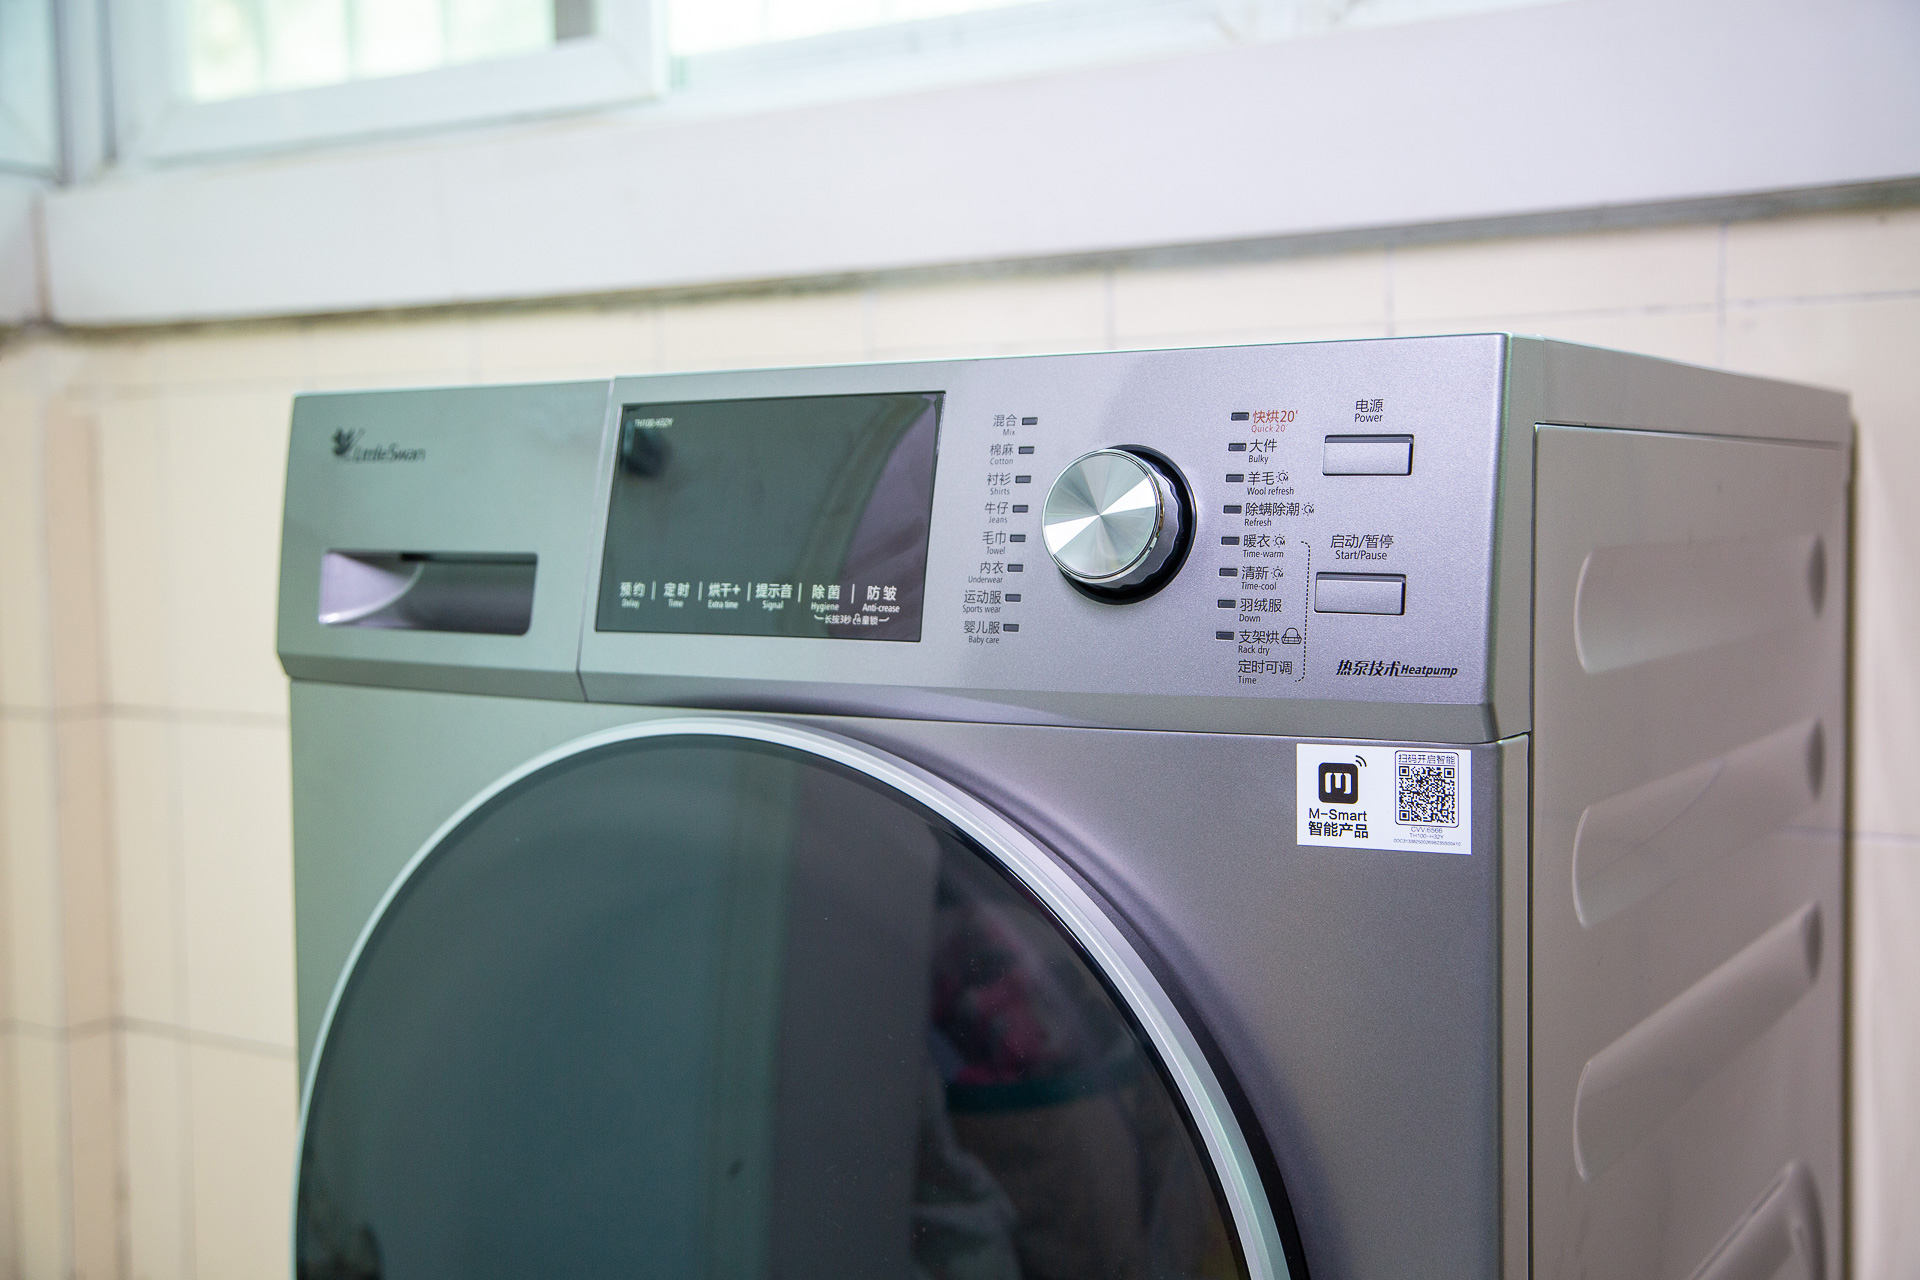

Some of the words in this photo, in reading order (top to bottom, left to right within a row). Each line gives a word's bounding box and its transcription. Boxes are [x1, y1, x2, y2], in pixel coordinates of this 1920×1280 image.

[1355, 399, 1384, 413] 电源
[993, 414, 1017, 427] 混合
[1355, 414, 1383, 422] Power
[990, 444, 1014, 456] 棉麻
[1249, 439, 1277, 453] 大件
[1249, 455, 1269, 464] Bulky
[987, 473, 1011, 485] 衬衫
[1247, 471, 1274, 485] 羊毛
[990, 487, 1010, 495] Shirts
[1247, 487, 1266, 495] Wool
[1268, 487, 1294, 495] refresh
[985, 502, 1009, 515] 牛仔
[1245, 503, 1300, 516] 除螨除潮
[1244, 518, 1272, 527] Refresh
[983, 531, 1006, 544] 毛巾
[1243, 534, 1270, 547] 暖衣
[1330, 534, 1394, 548] 启动/暂停
[1335, 550, 1387, 560] Start/Pause
[980, 562, 1004, 573] 内衣
[1242, 566, 1269, 580] 清新
[620, 582, 645, 597] 预约
[663, 582, 690, 597] 定时
[756, 584, 792, 599] 提示音
[812, 585, 840, 600] 除菌
[1241, 582, 1276, 590] Time-cool
[867, 586, 897, 600] 防皱
[964, 590, 1001, 604] 运动服
[668, 599, 684, 607] Time
[708, 599, 723, 609] Extra
[725, 600, 738, 609] time
[762, 600, 784, 610] Signal
[811, 602, 839, 612] Hygiene
[862, 603, 900, 612] Anti-crease
[963, 605, 983, 613] Sports
[1240, 598, 1282, 612] 羽绒服
[1239, 614, 1260, 623] Down
[964, 621, 1000, 634] 婴儿服
[969, 636, 984, 644] Baby
[1239, 630, 1279, 644] 支架烘
[1238, 646, 1256, 654] Rack
[1257, 646, 1269, 655] dry
[1238, 660, 1293, 675] 定时可调
[1336, 660, 1400, 676] 热泵技术
[1400, 665, 1458, 677] Heatpump
[1238, 676, 1256, 684] Time
[1398, 754, 1455, 764] 扫码开启智能
[1309, 808, 1367, 821] M-Smart
[1309, 821, 1368, 838] 智能产品
